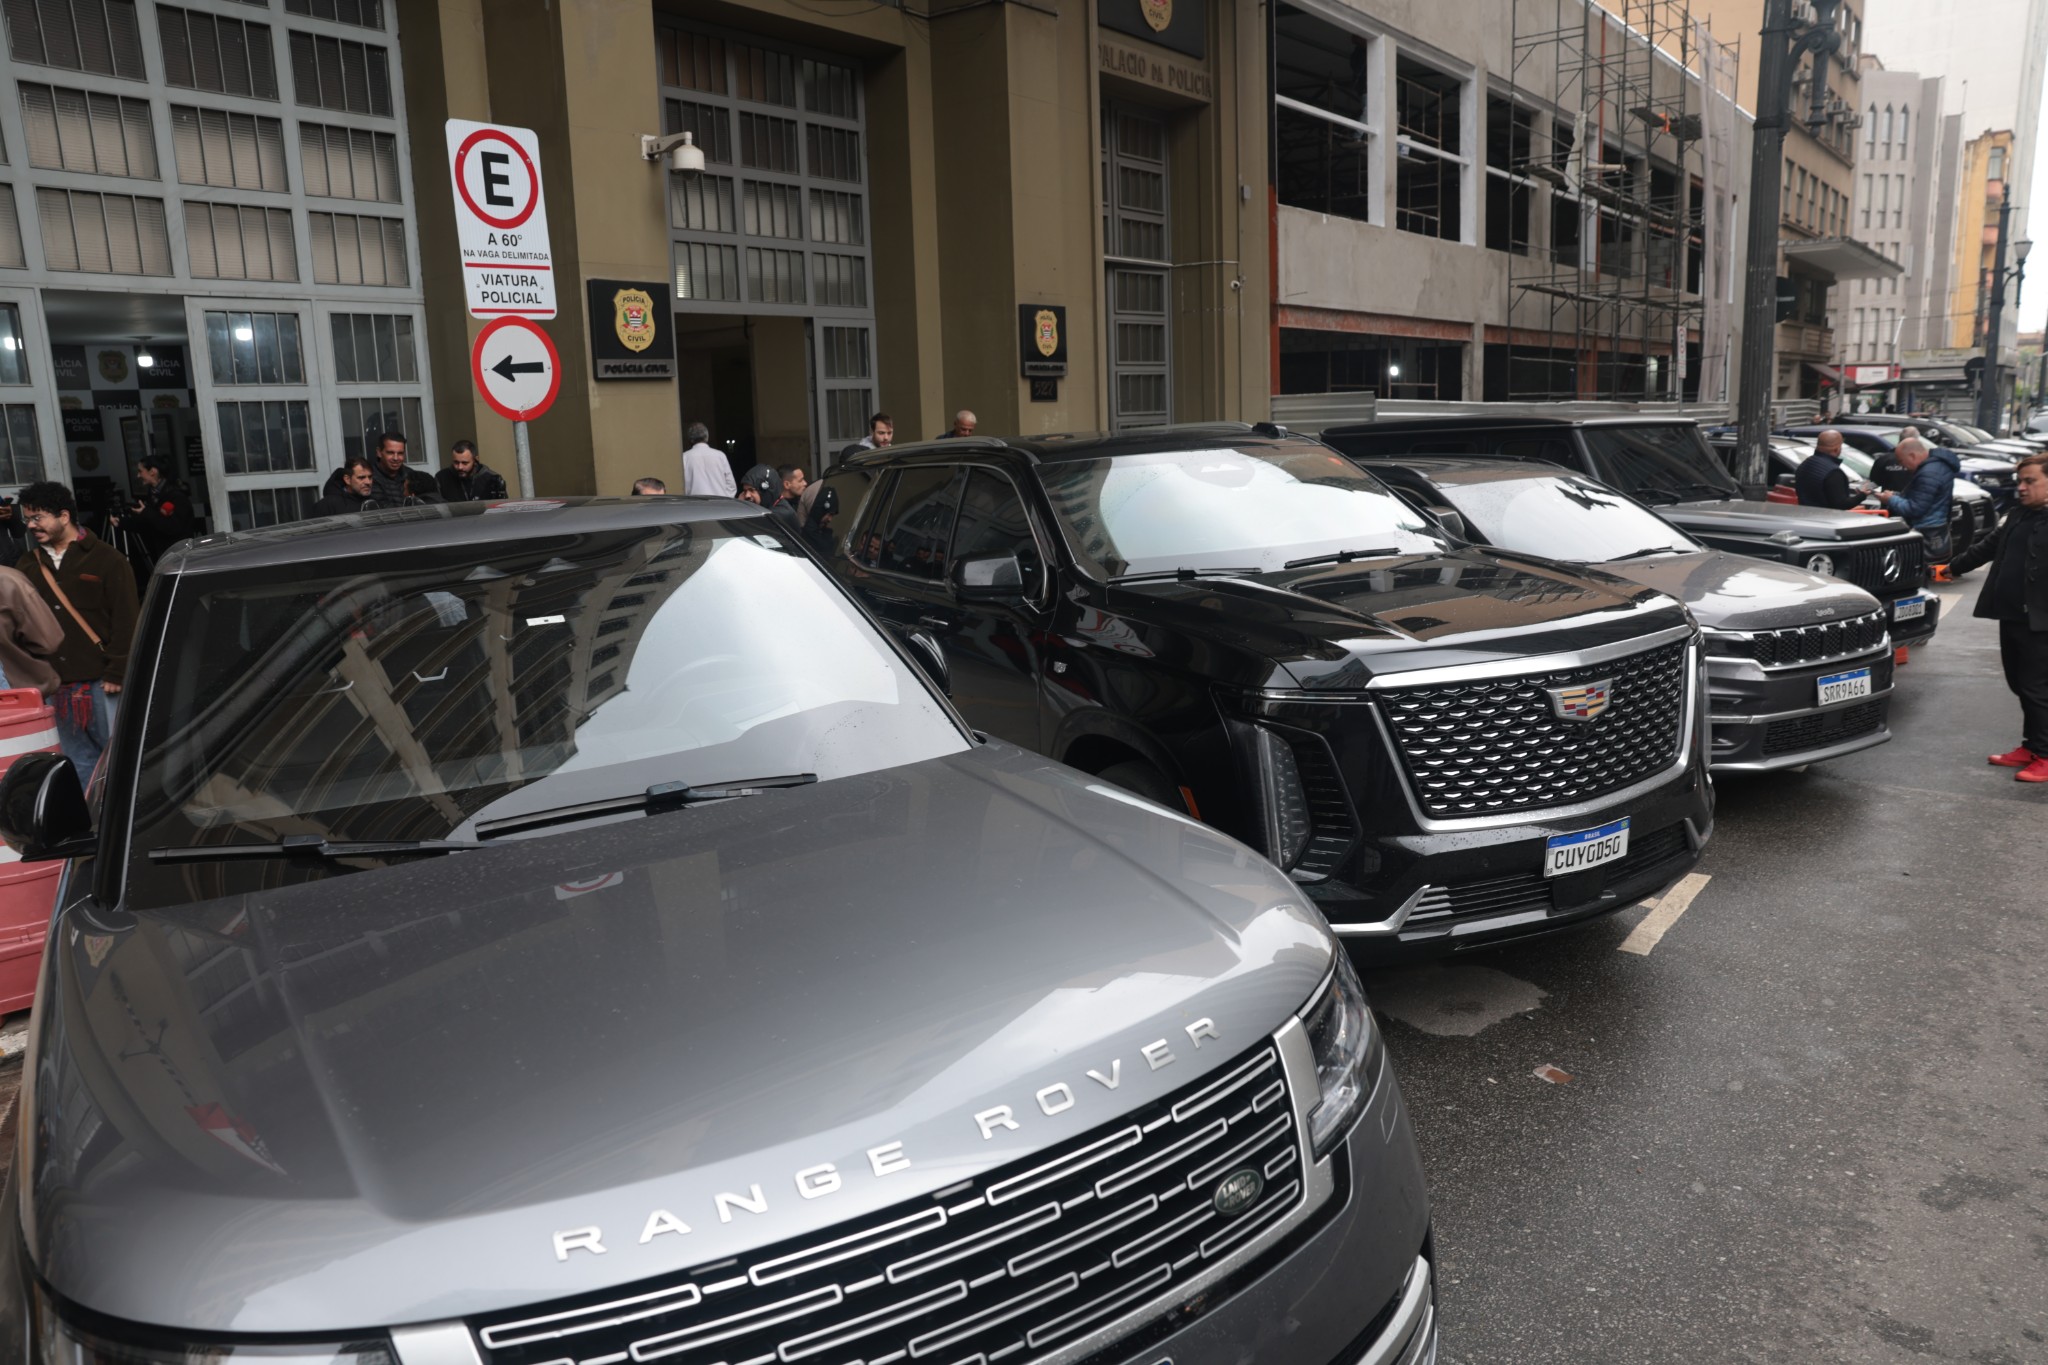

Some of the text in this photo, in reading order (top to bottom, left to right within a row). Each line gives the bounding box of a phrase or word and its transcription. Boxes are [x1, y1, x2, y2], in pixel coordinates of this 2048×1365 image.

[1149, 9, 1164, 20] CIVIL
[481, 151, 514, 207] E
[488, 233, 522, 247] A 60°
[464, 249, 549, 261] NA VAGA DELIMITADA
[481, 273, 538, 287] VIATURA
[482, 291, 542, 304] POLICIAL
[622, 295, 645, 304] POLÍCIA
[55, 358, 83, 368] LÍCIA
[604, 362, 670, 374] POLÍCIA CIVIL
[56, 369, 76, 377] IVIL
[149, 368, 175, 377] CIVIL
[1824, 679, 1866, 702] SRR9A66
[1584, 831, 1601, 840] BRASIL
[552, 1017, 1222, 1261] RANGE ROVER
